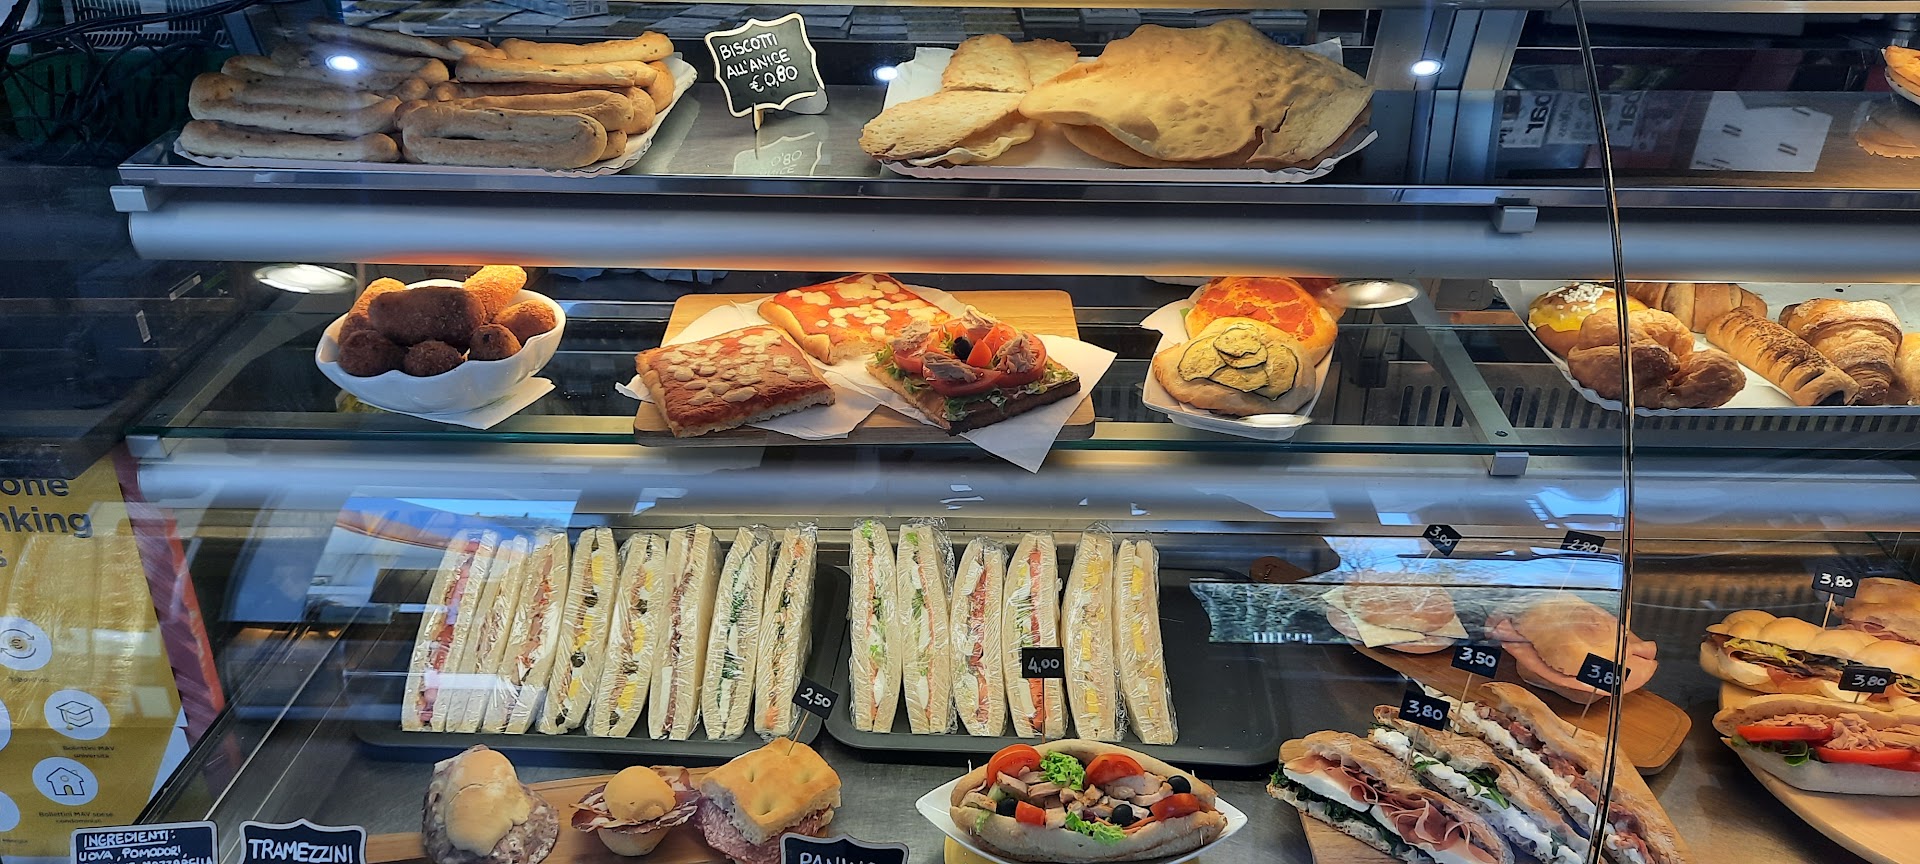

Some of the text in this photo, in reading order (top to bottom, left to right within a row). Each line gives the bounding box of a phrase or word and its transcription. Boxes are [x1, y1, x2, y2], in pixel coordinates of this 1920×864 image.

[719, 33, 778, 60] BISCOTTI
[726, 49, 791, 79] ALL'ANICE
[764, 65, 798, 88] 0,80
[1820, 573, 1853, 588] 3,80
[1027, 656, 1060, 674] 4,00
[1459, 647, 1496, 668] 3,50
[1852, 674, 1887, 687] 3,80
[800, 687, 831, 708] 2,50
[1406, 699, 1443, 720] 3,80
[84, 830, 176, 849] INGREDIENTI:
[248, 838, 354, 864] TRAMEZZINI
